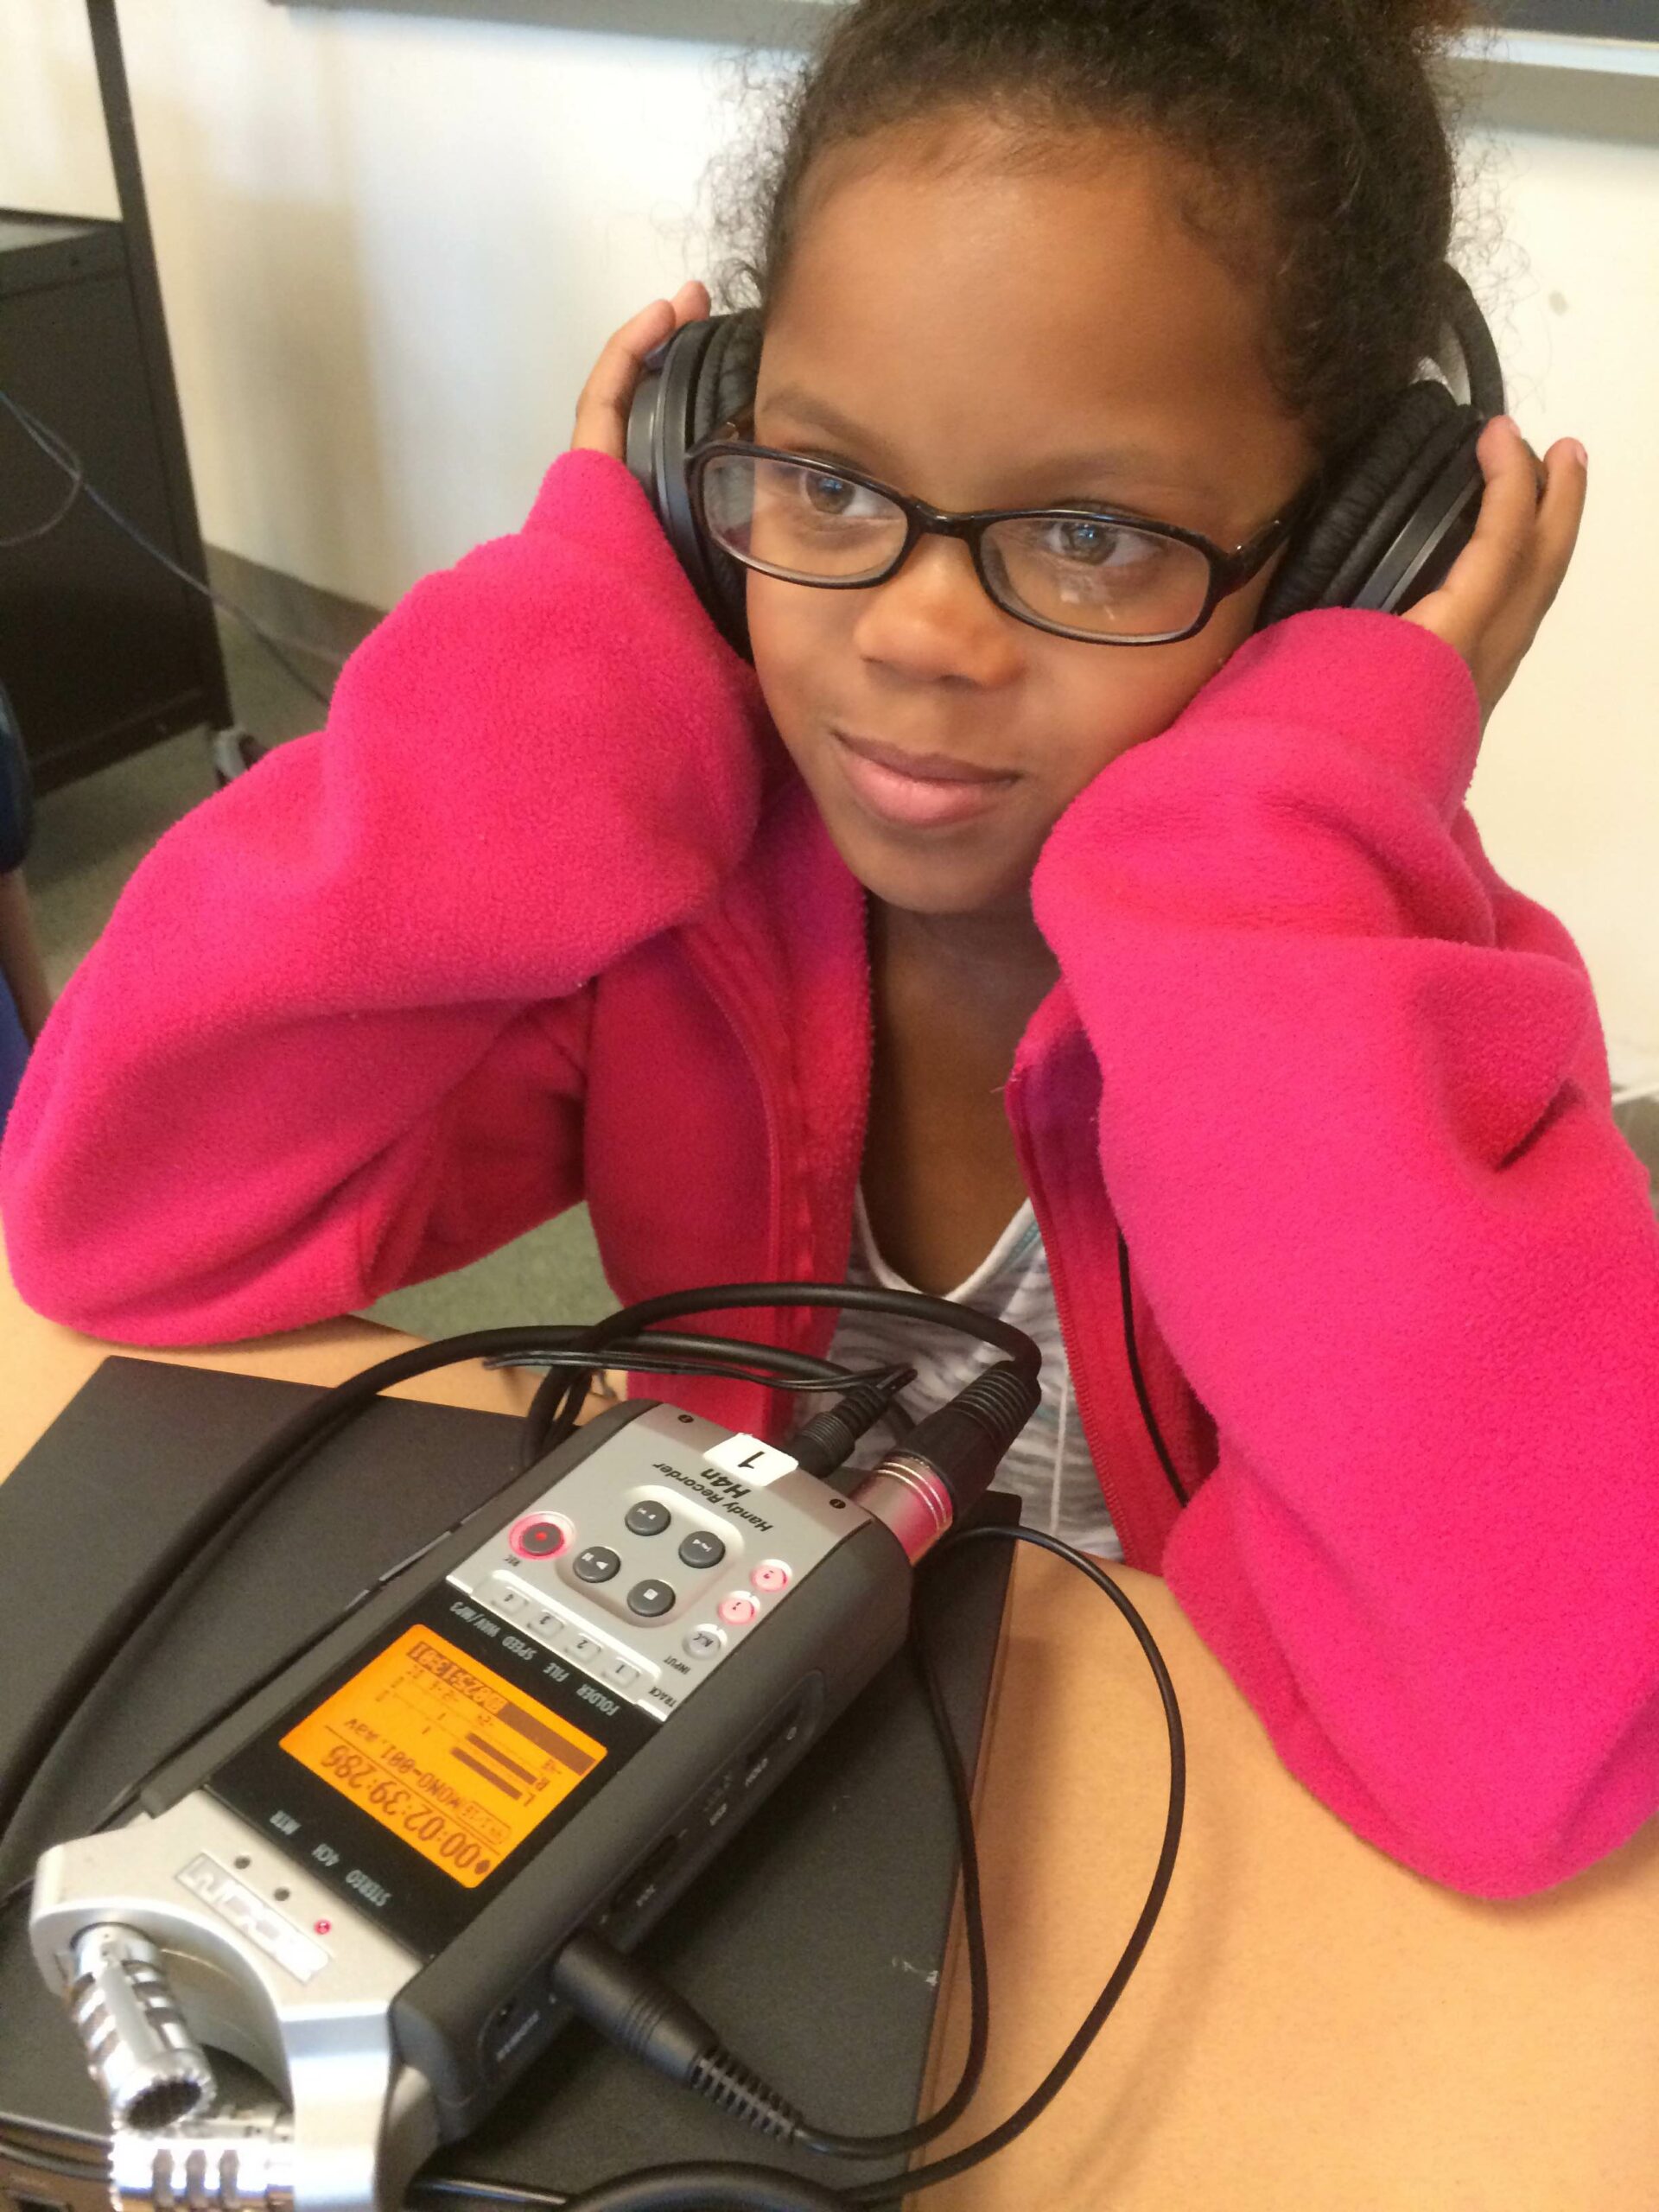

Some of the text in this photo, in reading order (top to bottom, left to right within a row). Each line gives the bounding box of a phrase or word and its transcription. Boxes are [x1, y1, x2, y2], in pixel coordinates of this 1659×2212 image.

[738, 1451, 765, 1470] 1
[701, 1468, 752, 1499] H4n
[652, 1463, 774, 1532] Handy Recorder
[576, 1639, 588, 1649] 2
[448, 1600, 621, 1717] FOLDER FILE SPEED WAV/MP3
[614, 1664, 626, 1674] 1
[664, 1655, 691, 1675] INPUT
[648, 1686, 677, 1707] TRACK
[269, 1809, 392, 1907] STEREO 4CH MTR
